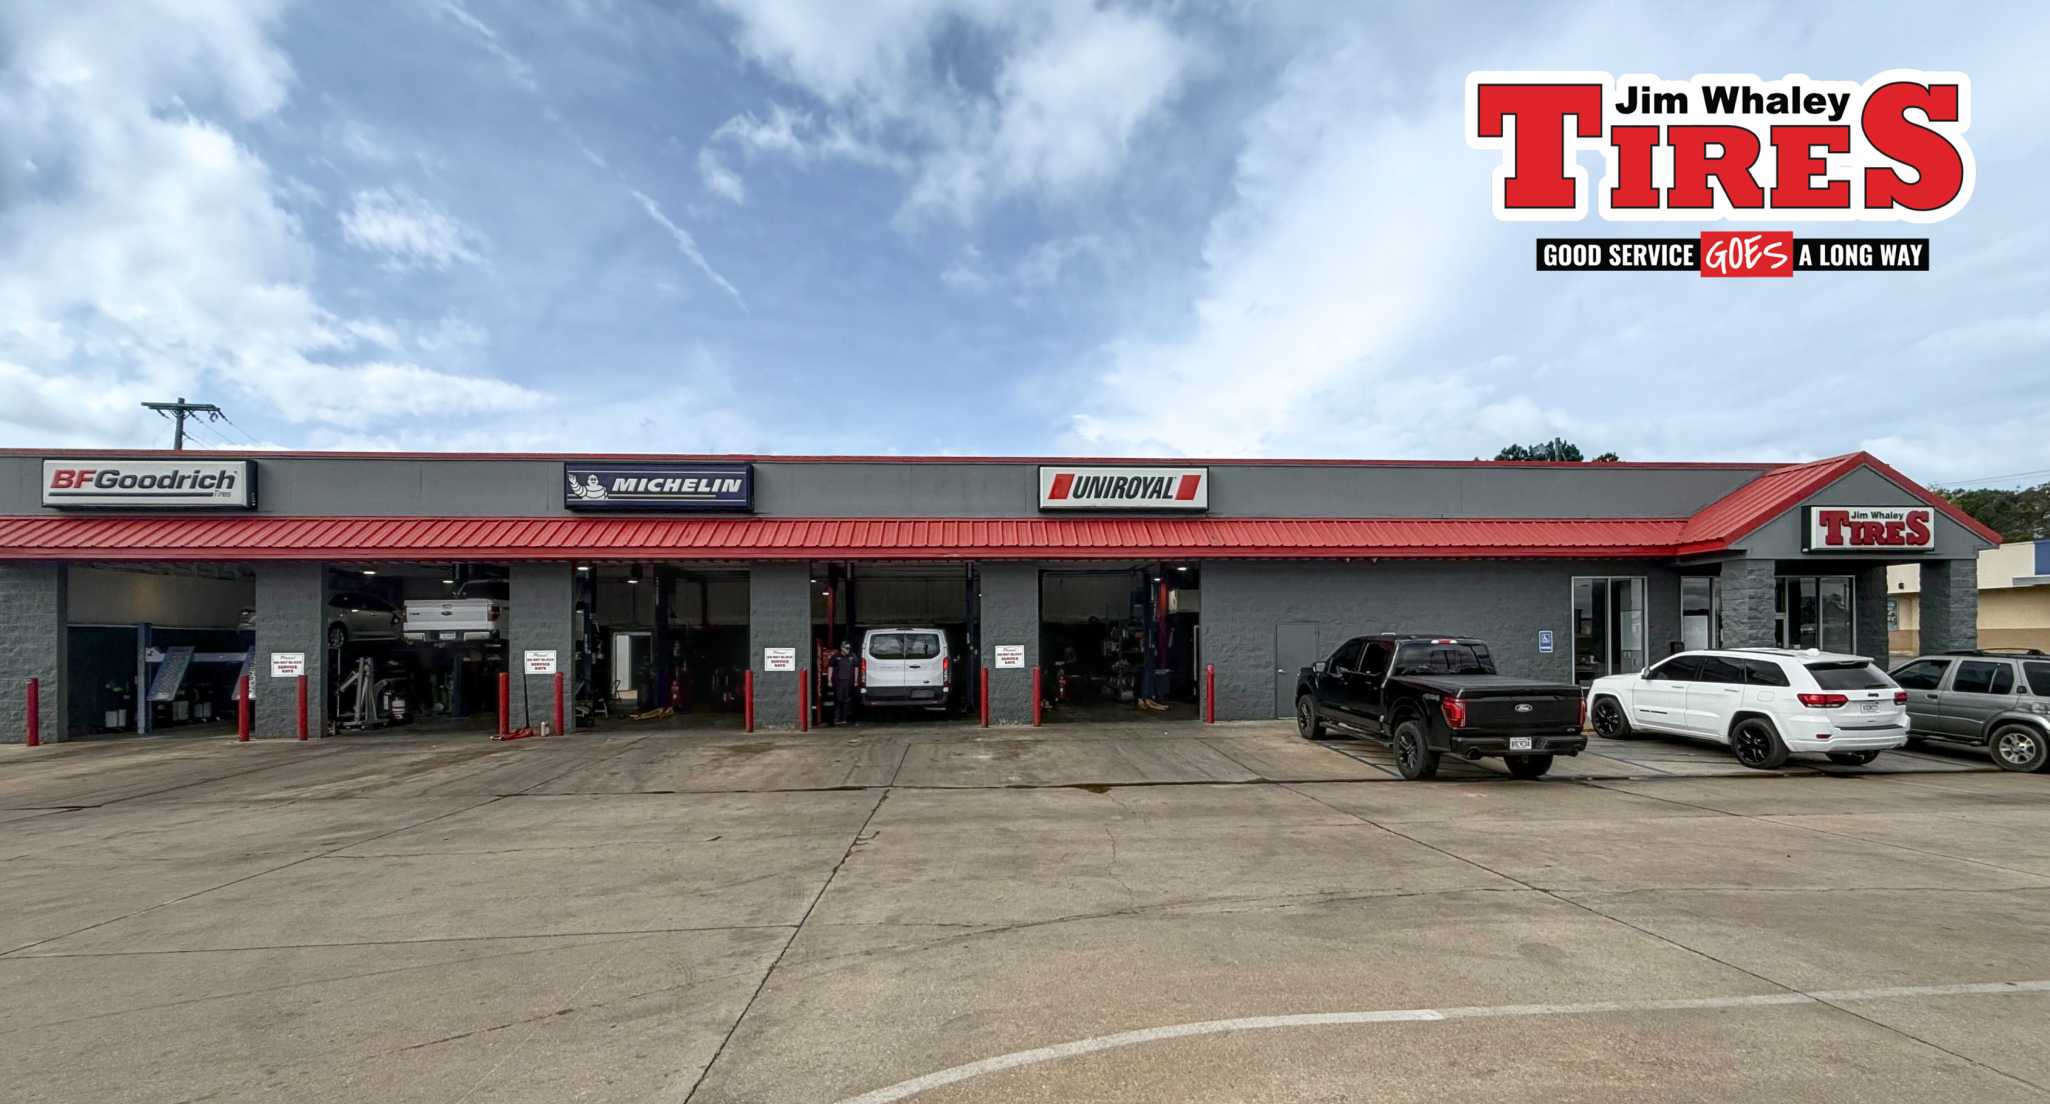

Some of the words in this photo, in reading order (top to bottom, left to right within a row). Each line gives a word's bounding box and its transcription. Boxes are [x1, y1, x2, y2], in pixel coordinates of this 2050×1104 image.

[49, 469, 237, 490] BFGoodrich
[611, 478, 743, 493] MICHELIN
[1072, 475, 1174, 500] UNIROYAL
[1850, 511, 1869, 520] Jim
[1870, 511, 1905, 520] Whaley
[1818, 510, 1931, 546] TIRES
